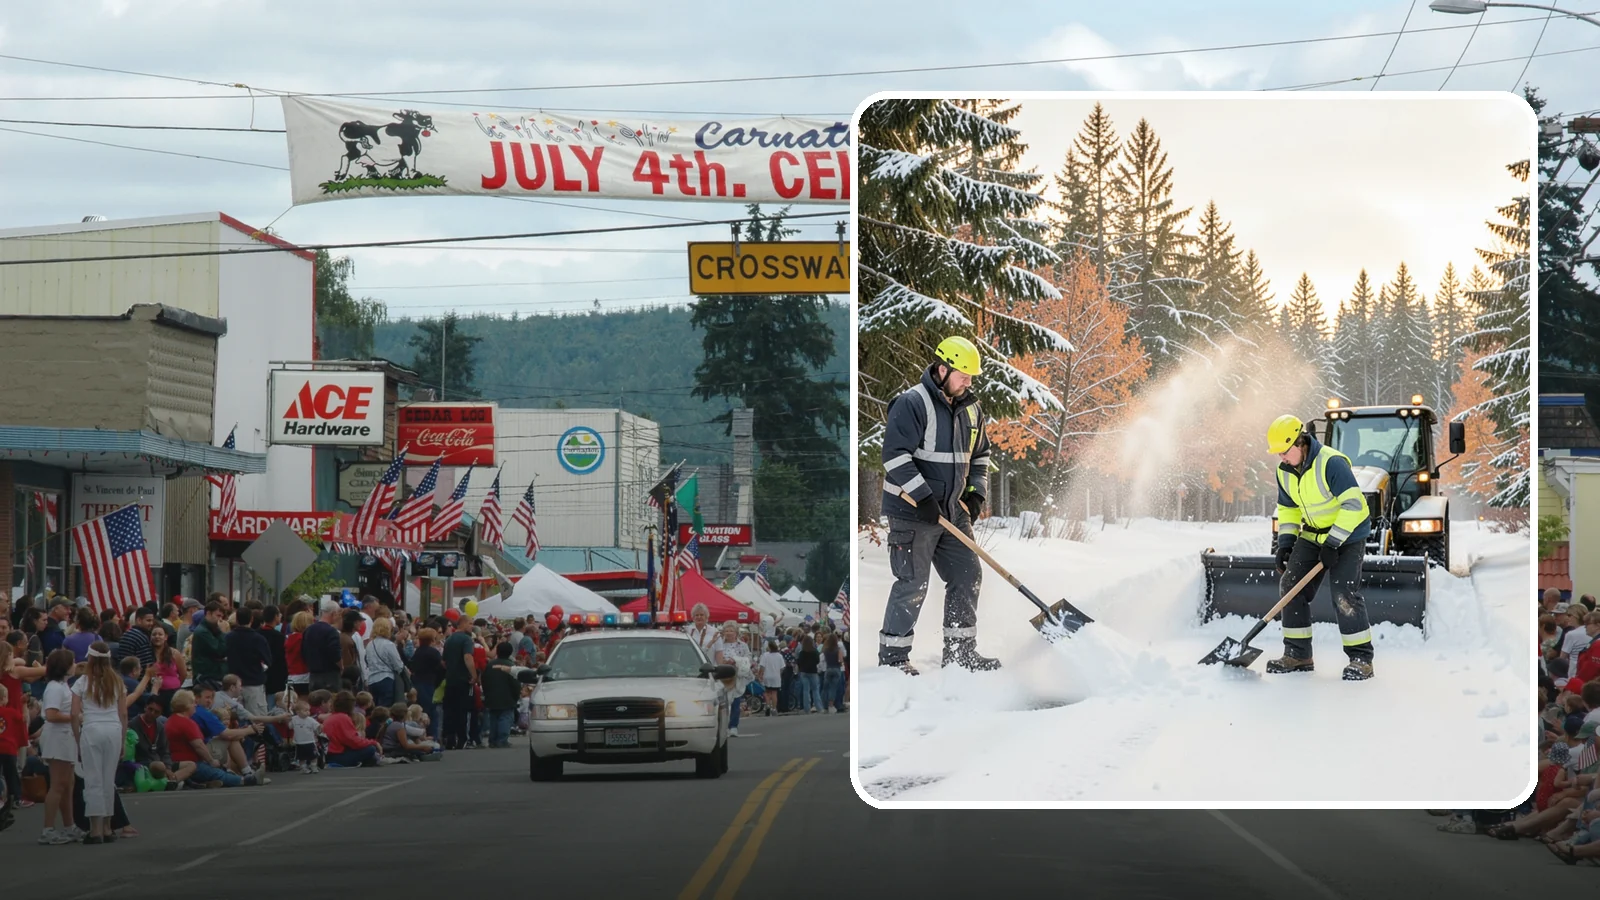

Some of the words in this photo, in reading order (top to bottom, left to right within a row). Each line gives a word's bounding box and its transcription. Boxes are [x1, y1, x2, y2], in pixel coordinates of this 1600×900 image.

[695, 121, 850, 149] Carnat
[481, 141, 604, 193] JULY
[632, 150, 746, 197] 4th.
[697, 254, 850, 280] CROSSWA
[283, 380, 373, 420] ACE
[406, 408, 453, 422] CEDAR
[461, 409, 485, 422] LOG
[284, 421, 371, 436] Hardware
[416, 428, 477, 447] Coca-Cola
[353, 467, 384, 480] Simpl
[83, 485, 93, 494] St.
[95, 485, 124, 495] Vincent
[126, 486, 136, 495] de
[137, 486, 155, 495] Paul
[213, 516, 330, 535] HARDARE
[688, 526, 741, 535] CRNATION
[699, 535, 730, 543] GLASS
